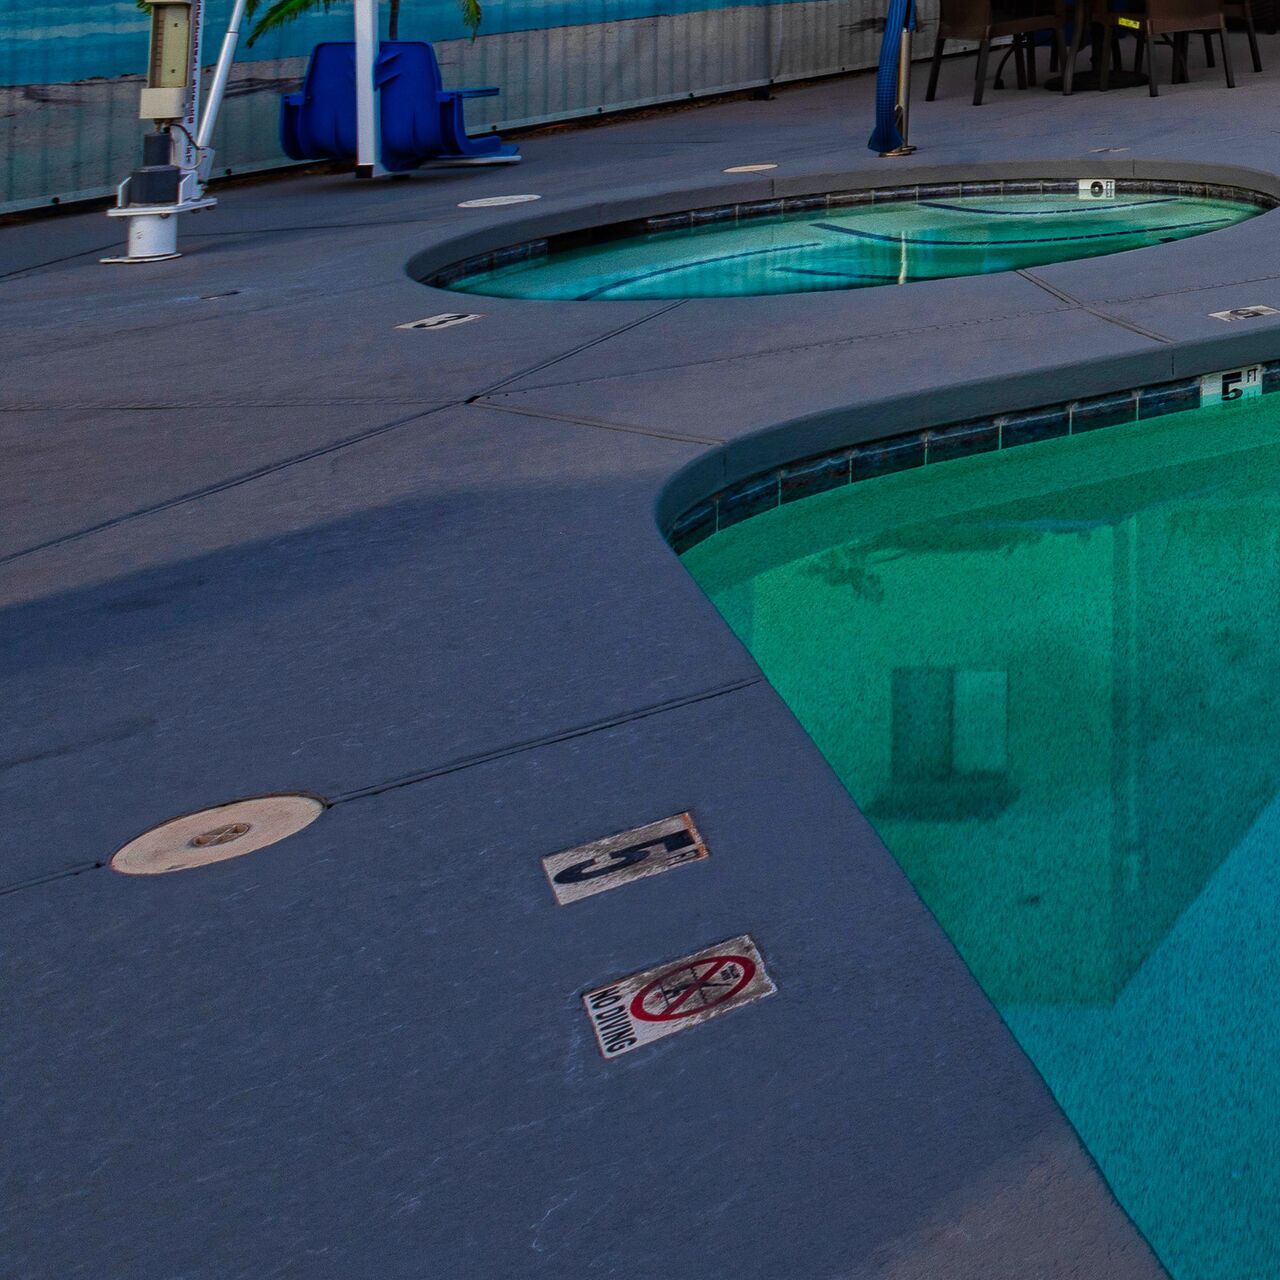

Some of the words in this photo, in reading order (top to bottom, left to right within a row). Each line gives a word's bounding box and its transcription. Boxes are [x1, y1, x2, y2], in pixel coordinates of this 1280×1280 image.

[1222, 372, 1243, 400] 5
[1247, 369, 1257, 382] FT
[554, 829, 695, 884] 5
[589, 986, 622, 1009] NO
[596, 1005, 637, 1053] DIVING
